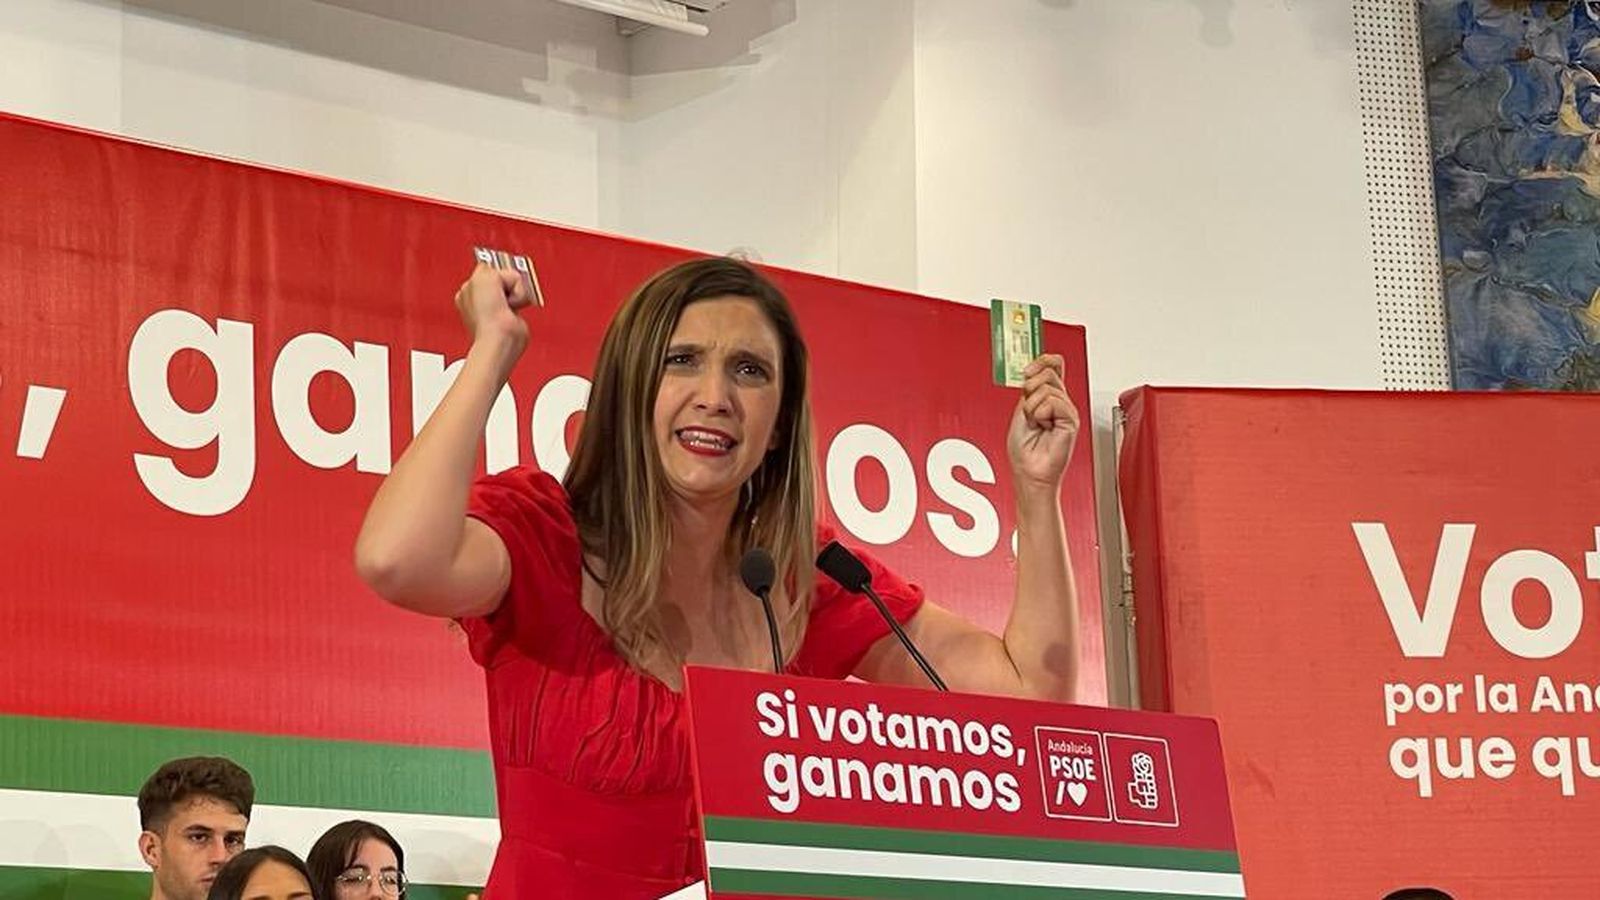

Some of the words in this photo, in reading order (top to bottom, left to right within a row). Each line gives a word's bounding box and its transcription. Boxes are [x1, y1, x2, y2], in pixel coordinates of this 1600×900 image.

[756, 690, 797, 739] Si
[808, 703, 1026, 767] votamos,
[1384, 683, 1463, 726] por
[1475, 674, 1518, 713] la
[1530, 675, 1600, 713] An
[763, 752, 1021, 813] ganamos
[1050, 755, 1096, 781] PSOE
[1389, 737, 1516, 797] que
